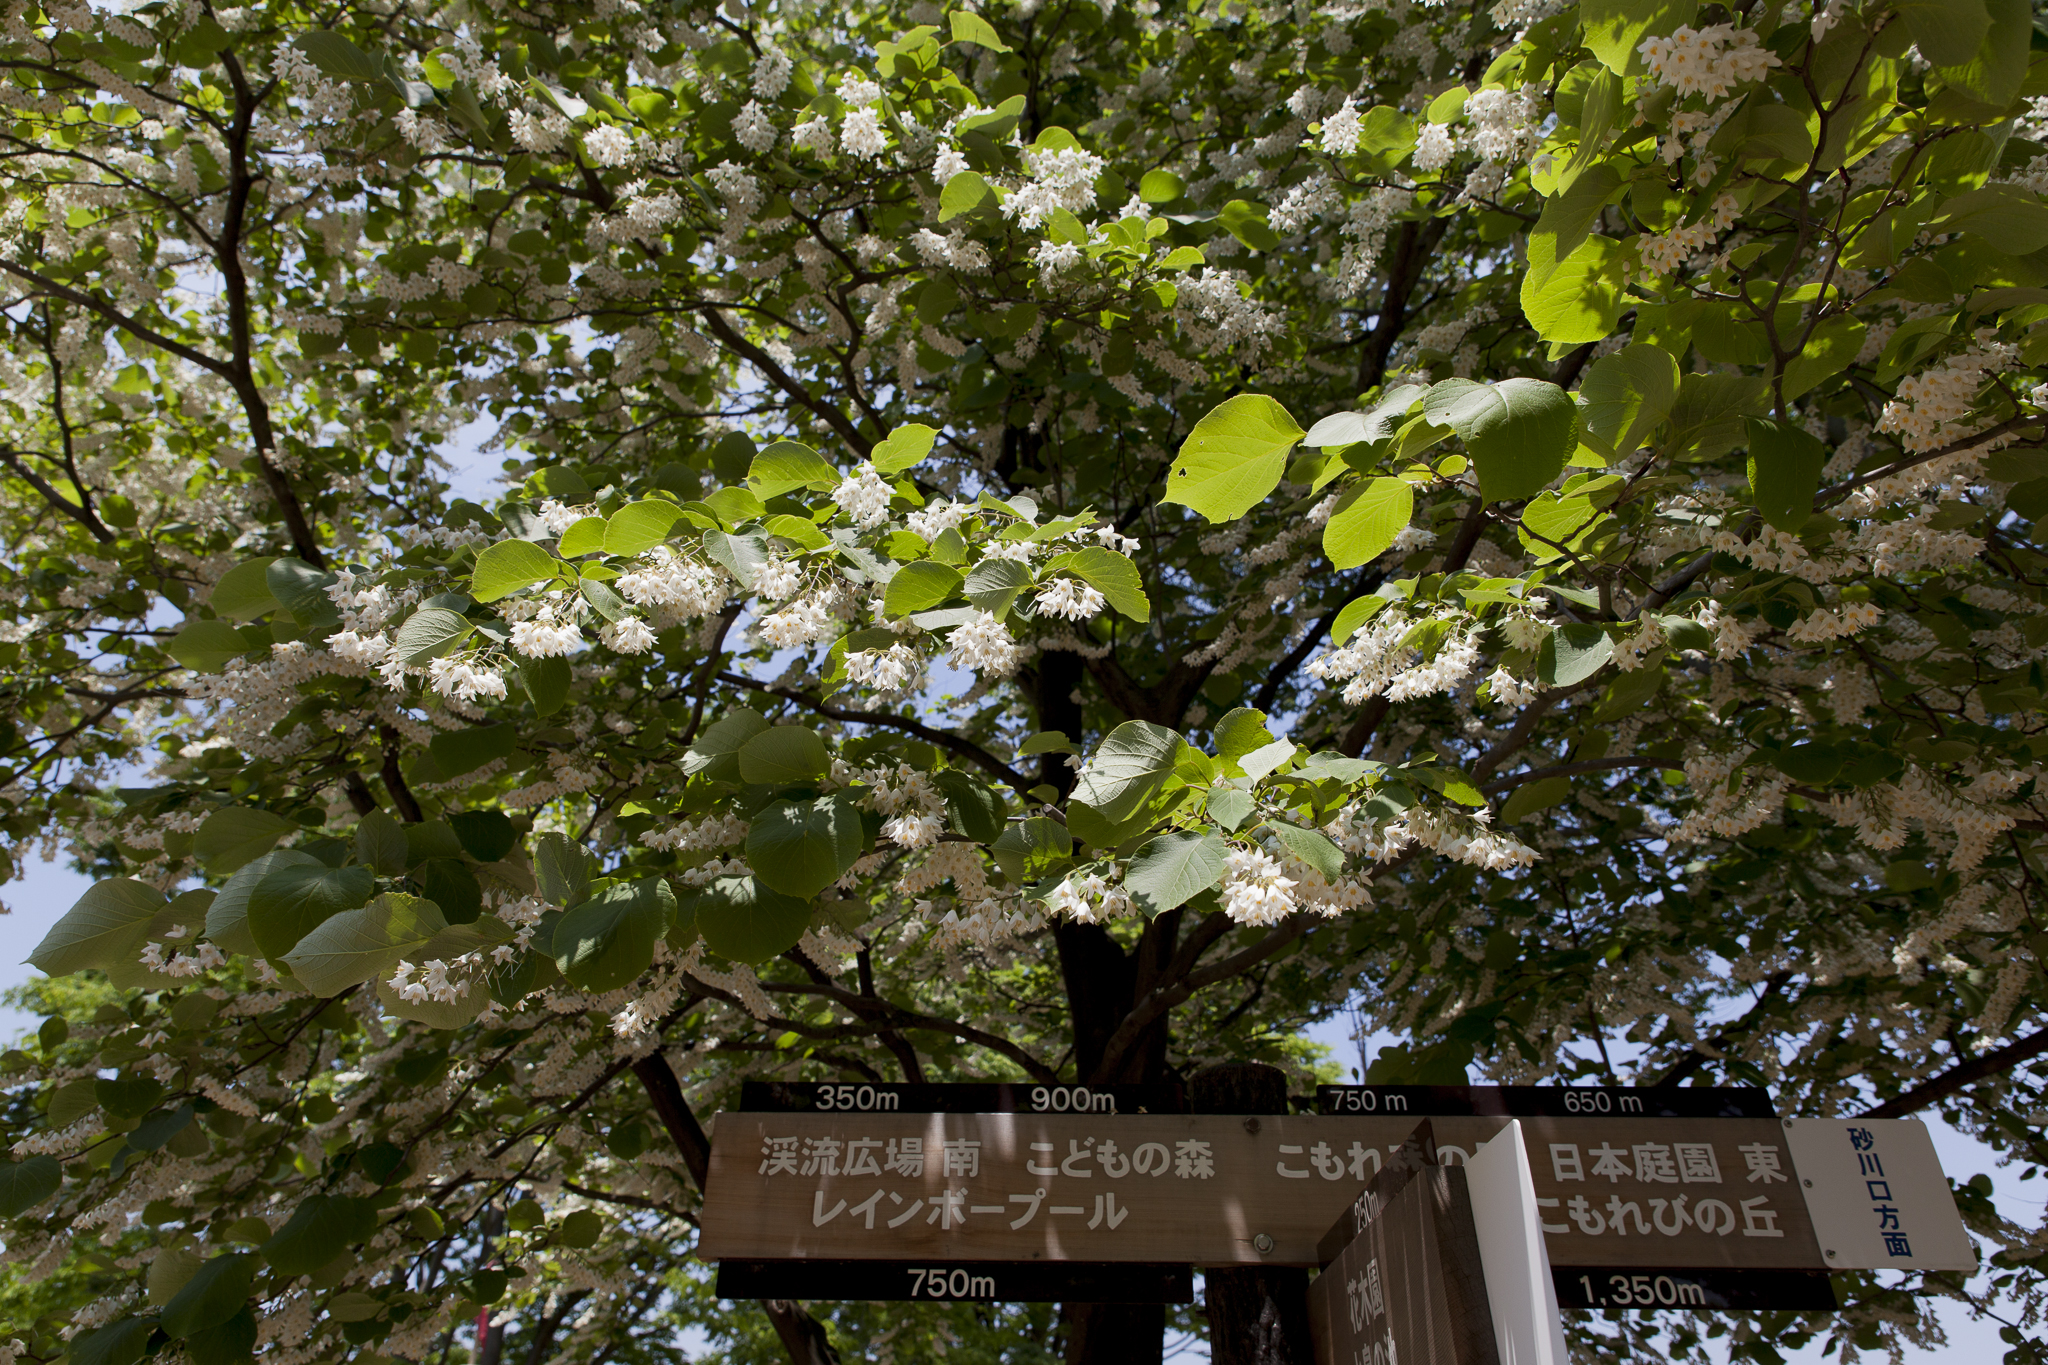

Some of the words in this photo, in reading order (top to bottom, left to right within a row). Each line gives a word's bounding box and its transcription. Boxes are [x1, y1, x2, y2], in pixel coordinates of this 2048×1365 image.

[815, 1085, 900, 1111] 350m
[1031, 1086, 1116, 1112] 900m
[1330, 1090, 1377, 1111] 750
[1564, 1091, 1612, 1113] 650
[758, 1136, 924, 1178] 渓流広場
[942, 1138, 982, 1178] 南
[1026, 1136, 1216, 1179] こどもの森
[1548, 1142, 1723, 1184] 日本庭園
[1738, 1142, 1789, 1184] 東
[812, 1187, 1129, 1230] レインボープール
[1354, 1190, 1380, 1235] 250m
[1846, 1127, 1913, 1258] 砂川口方面
[1537, 1194, 1783, 1235] こもれびの丘
[907, 1268, 996, 1298] 750m
[1346, 1257, 1385, 1334] 花木園
[1579, 1275, 1706, 1306] 1,350m
